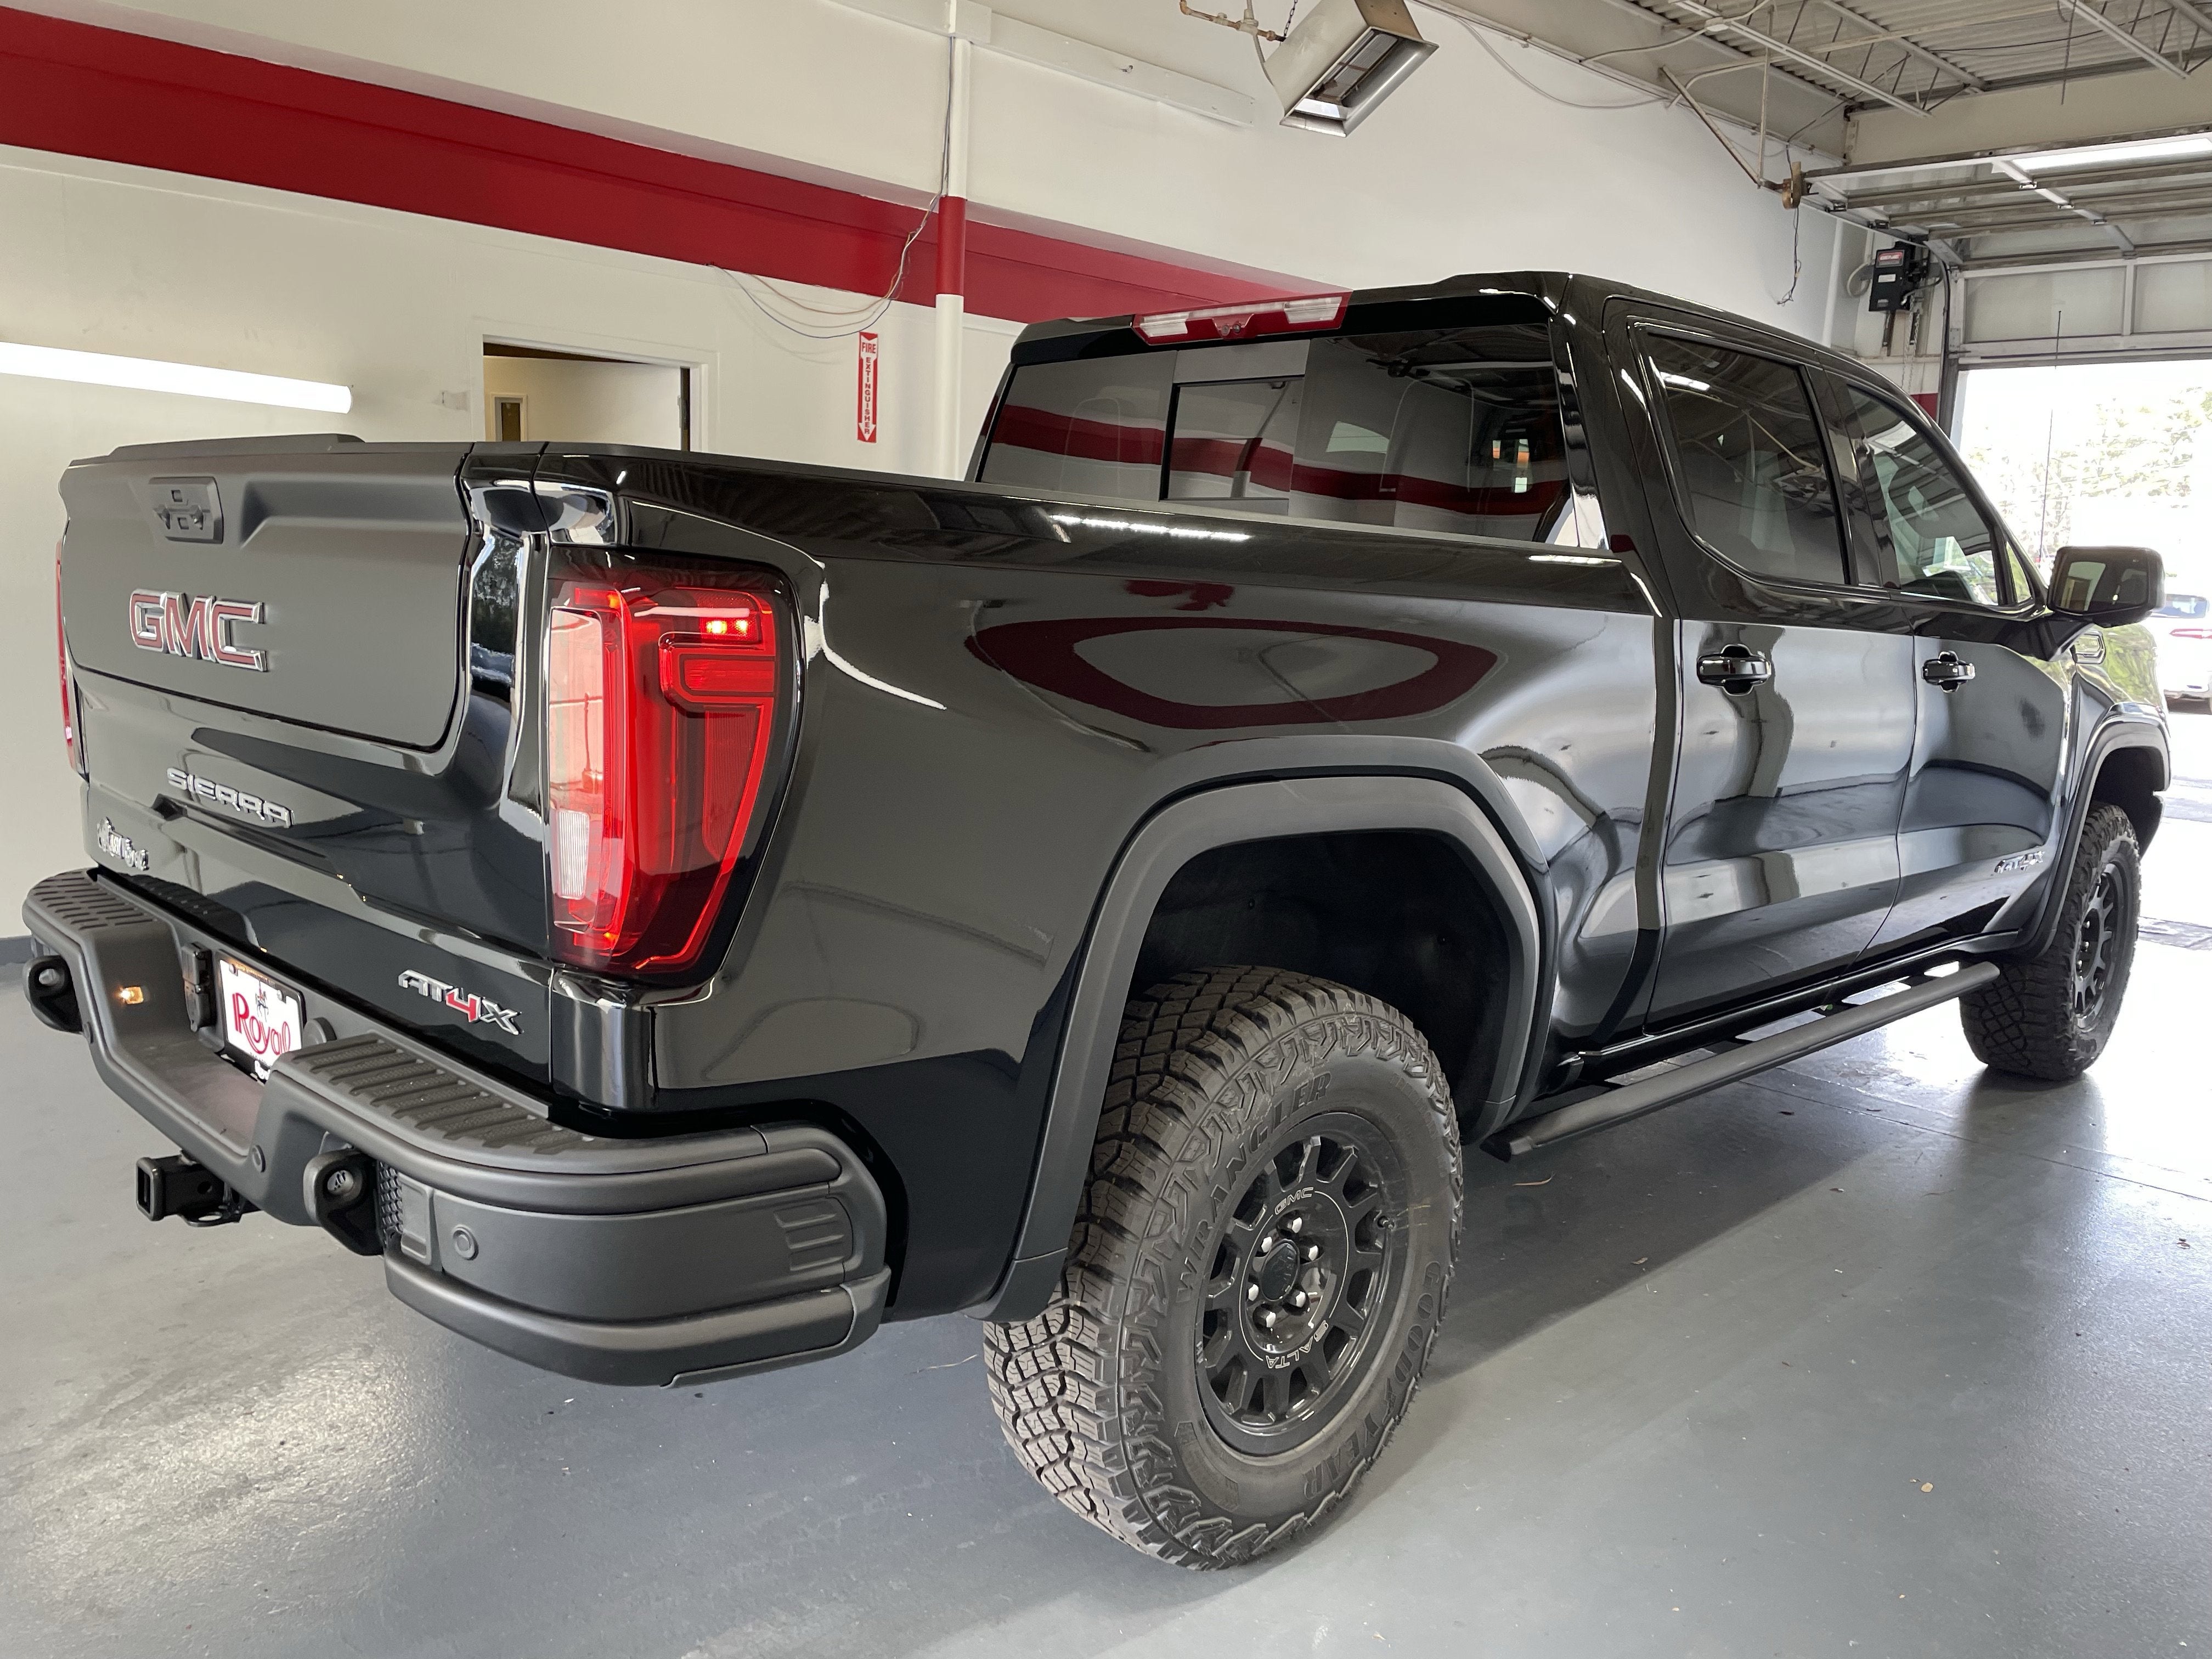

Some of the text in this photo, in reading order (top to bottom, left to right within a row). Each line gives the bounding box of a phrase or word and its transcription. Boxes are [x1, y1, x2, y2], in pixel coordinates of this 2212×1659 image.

[862, 342, 876, 353] FIRE
[129, 589, 267, 672] GMC
[167, 768, 292, 828] SIERRA
[232, 992, 291, 1056] Royal
[398, 969, 520, 1035] AT4X
[1176, 1071, 1332, 1302] WRANGLER
[1274, 1187, 1314, 1215] GMC
